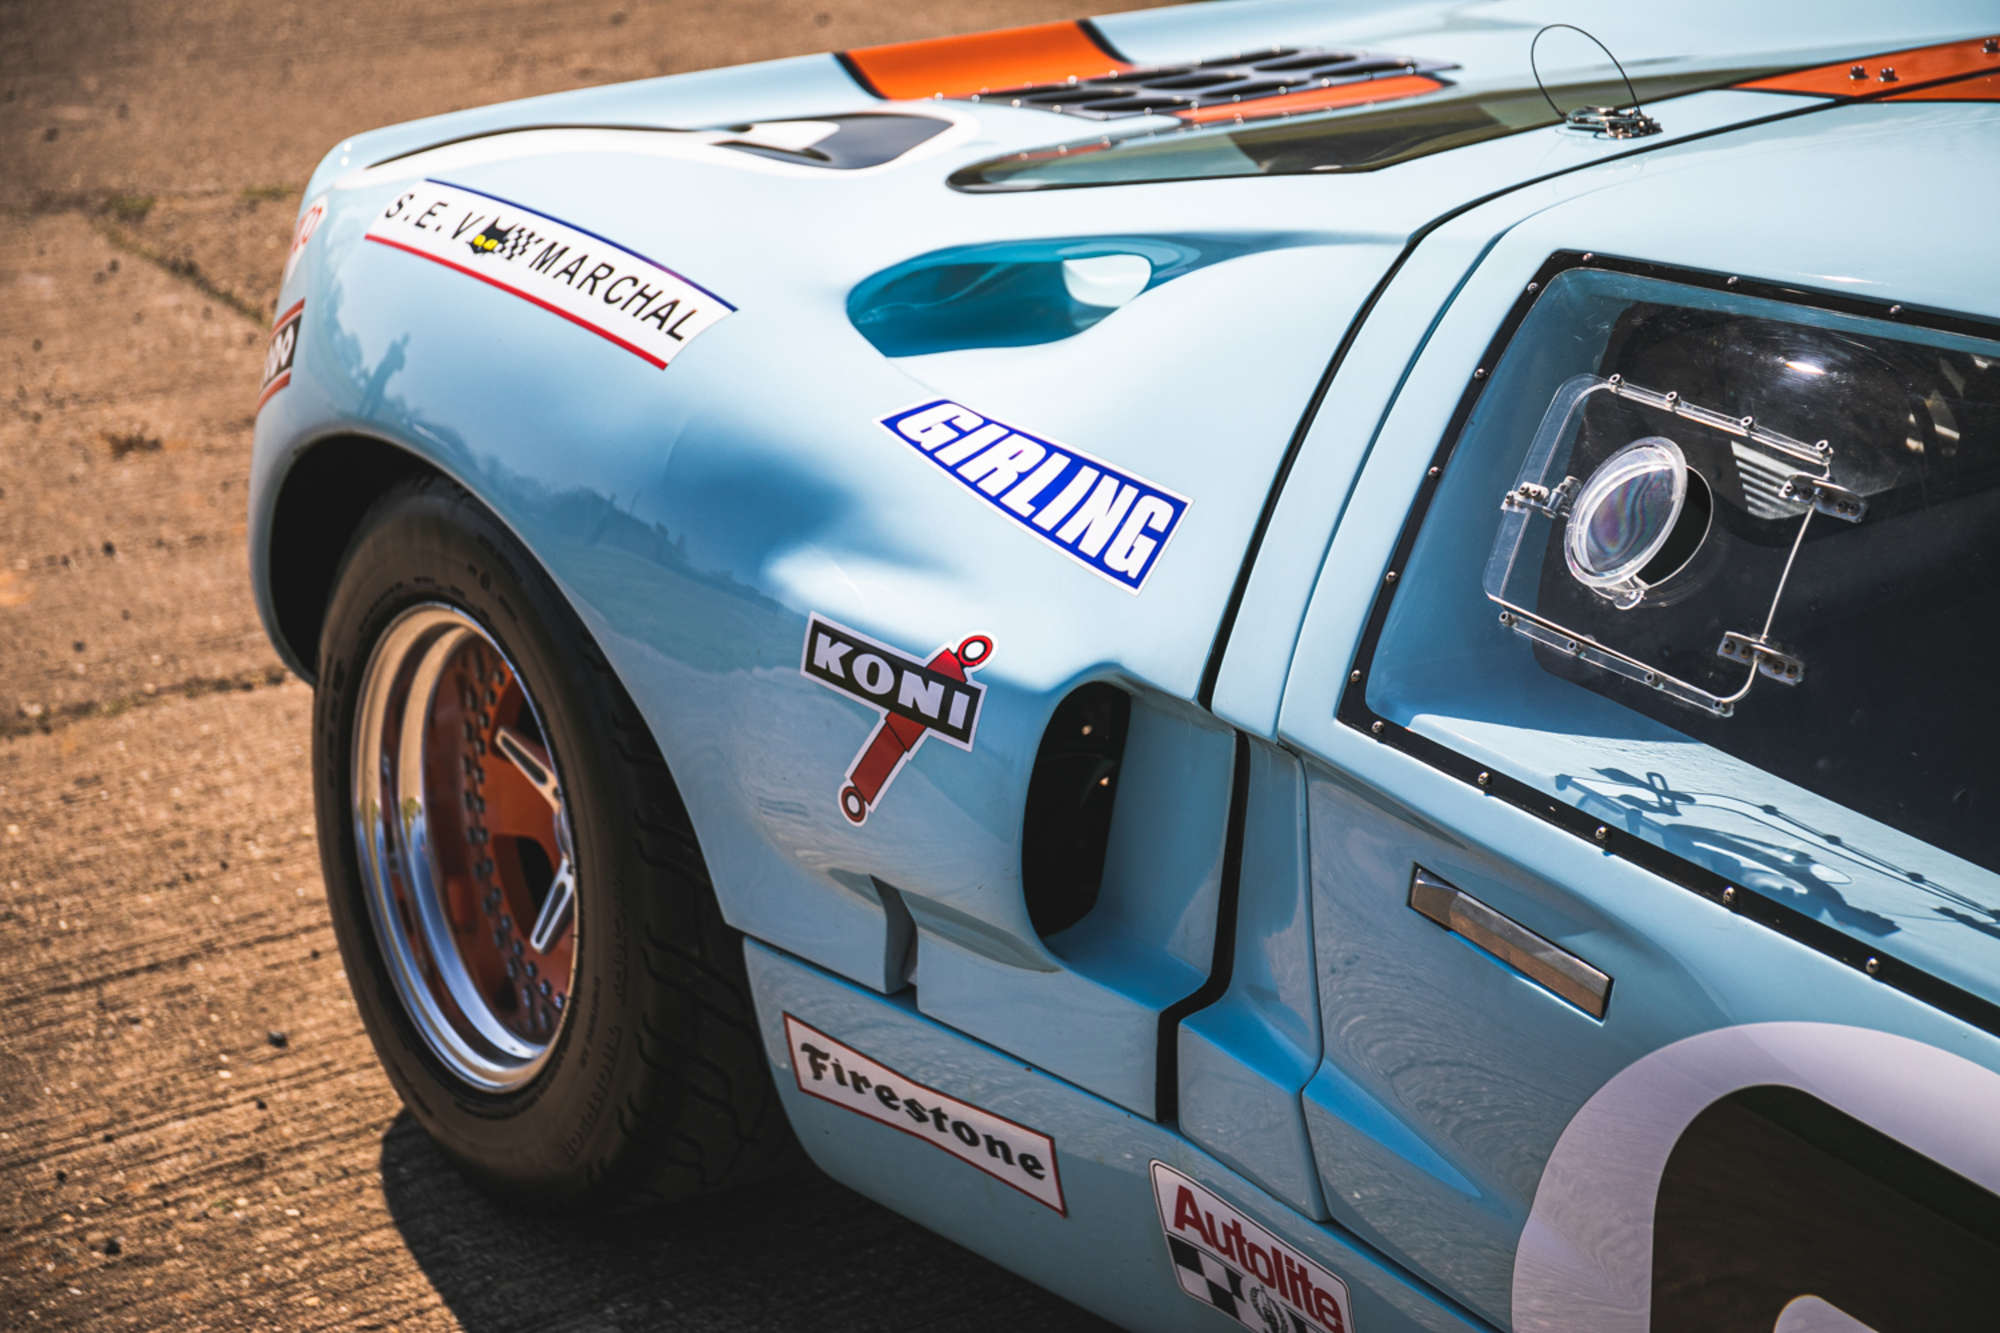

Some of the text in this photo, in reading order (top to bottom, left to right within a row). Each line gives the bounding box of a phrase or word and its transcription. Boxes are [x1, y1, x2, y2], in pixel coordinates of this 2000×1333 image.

[528, 241, 697, 342] MARCHAL
[896, 402, 1175, 579] GIRLING
[813, 632, 970, 729] KONI
[800, 1042, 1047, 1181] Firestone
[1174, 1185, 1345, 1333] Autolite
